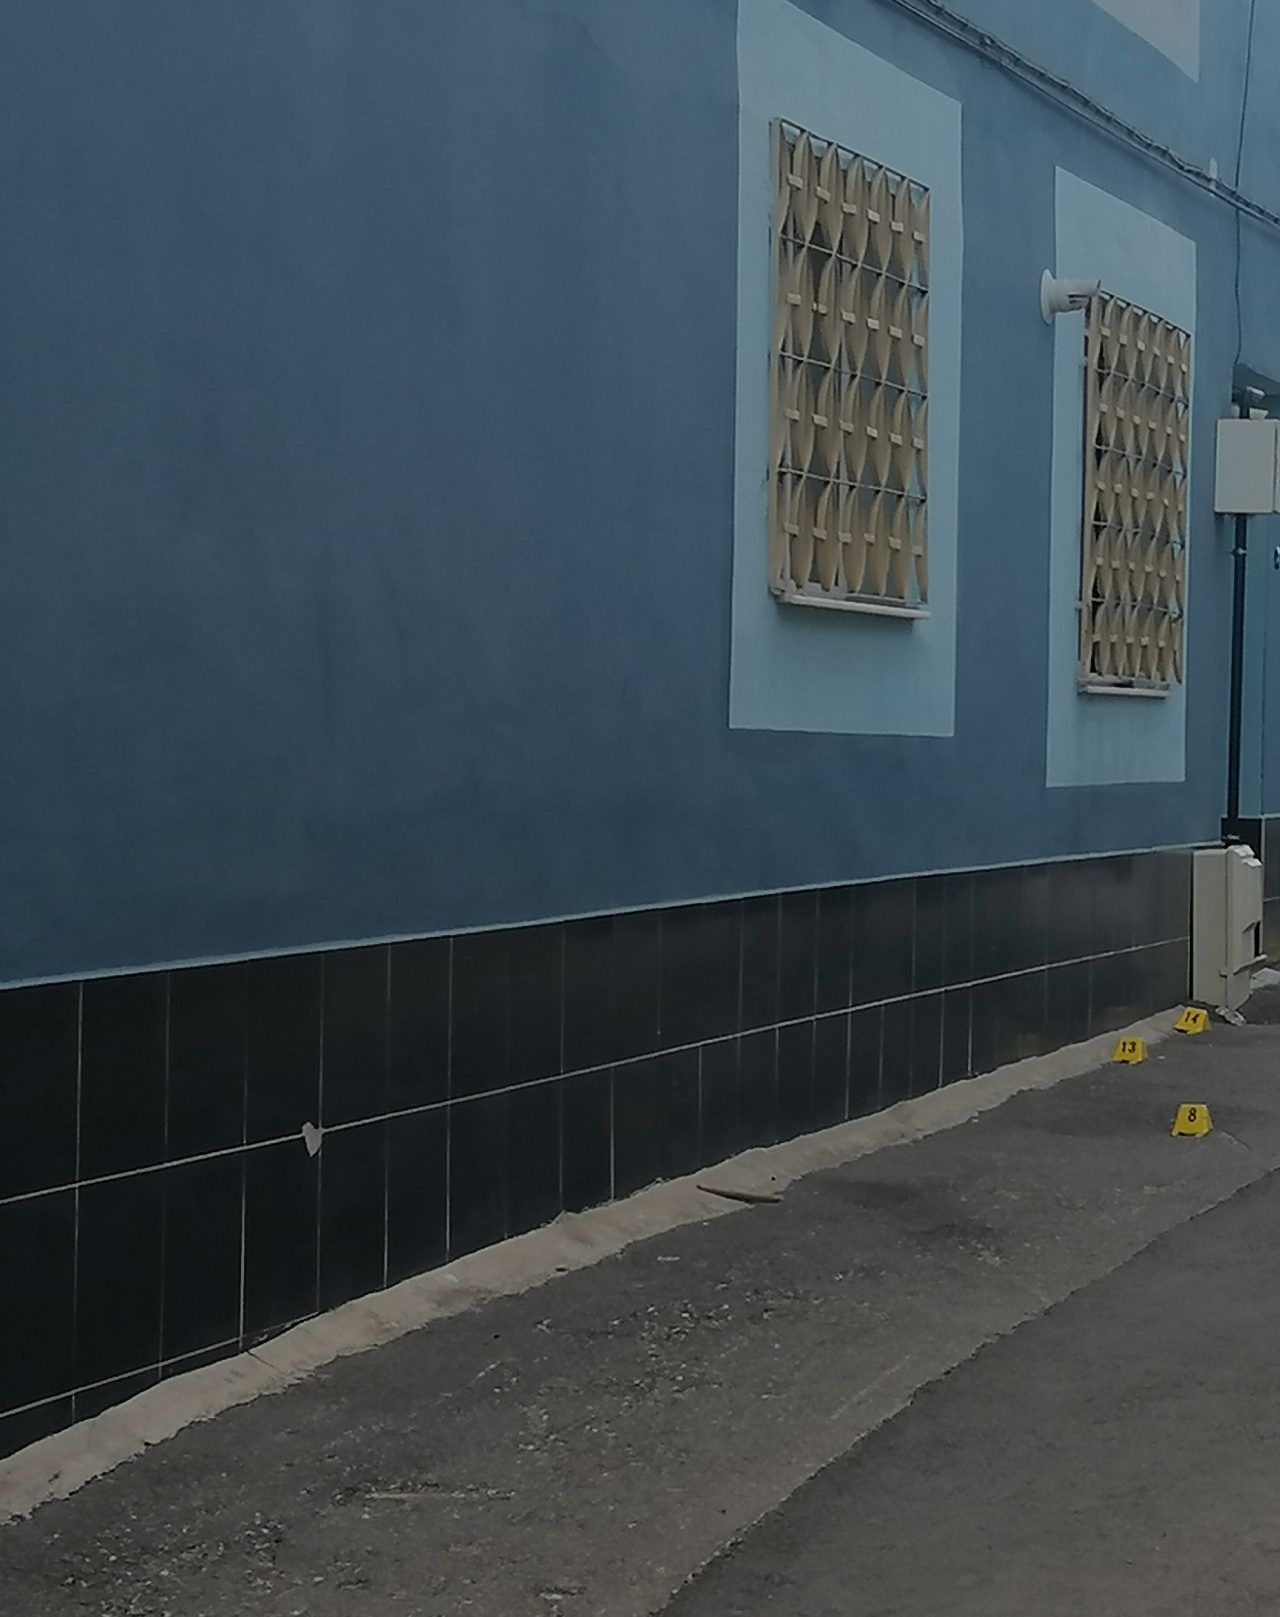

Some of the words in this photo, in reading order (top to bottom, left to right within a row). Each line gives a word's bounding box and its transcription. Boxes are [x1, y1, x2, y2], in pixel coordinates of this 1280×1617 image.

[1184, 1011, 1199, 1025] 14
[1121, 1040, 1136, 1054] 13
[1187, 1107, 1197, 1122] 8
